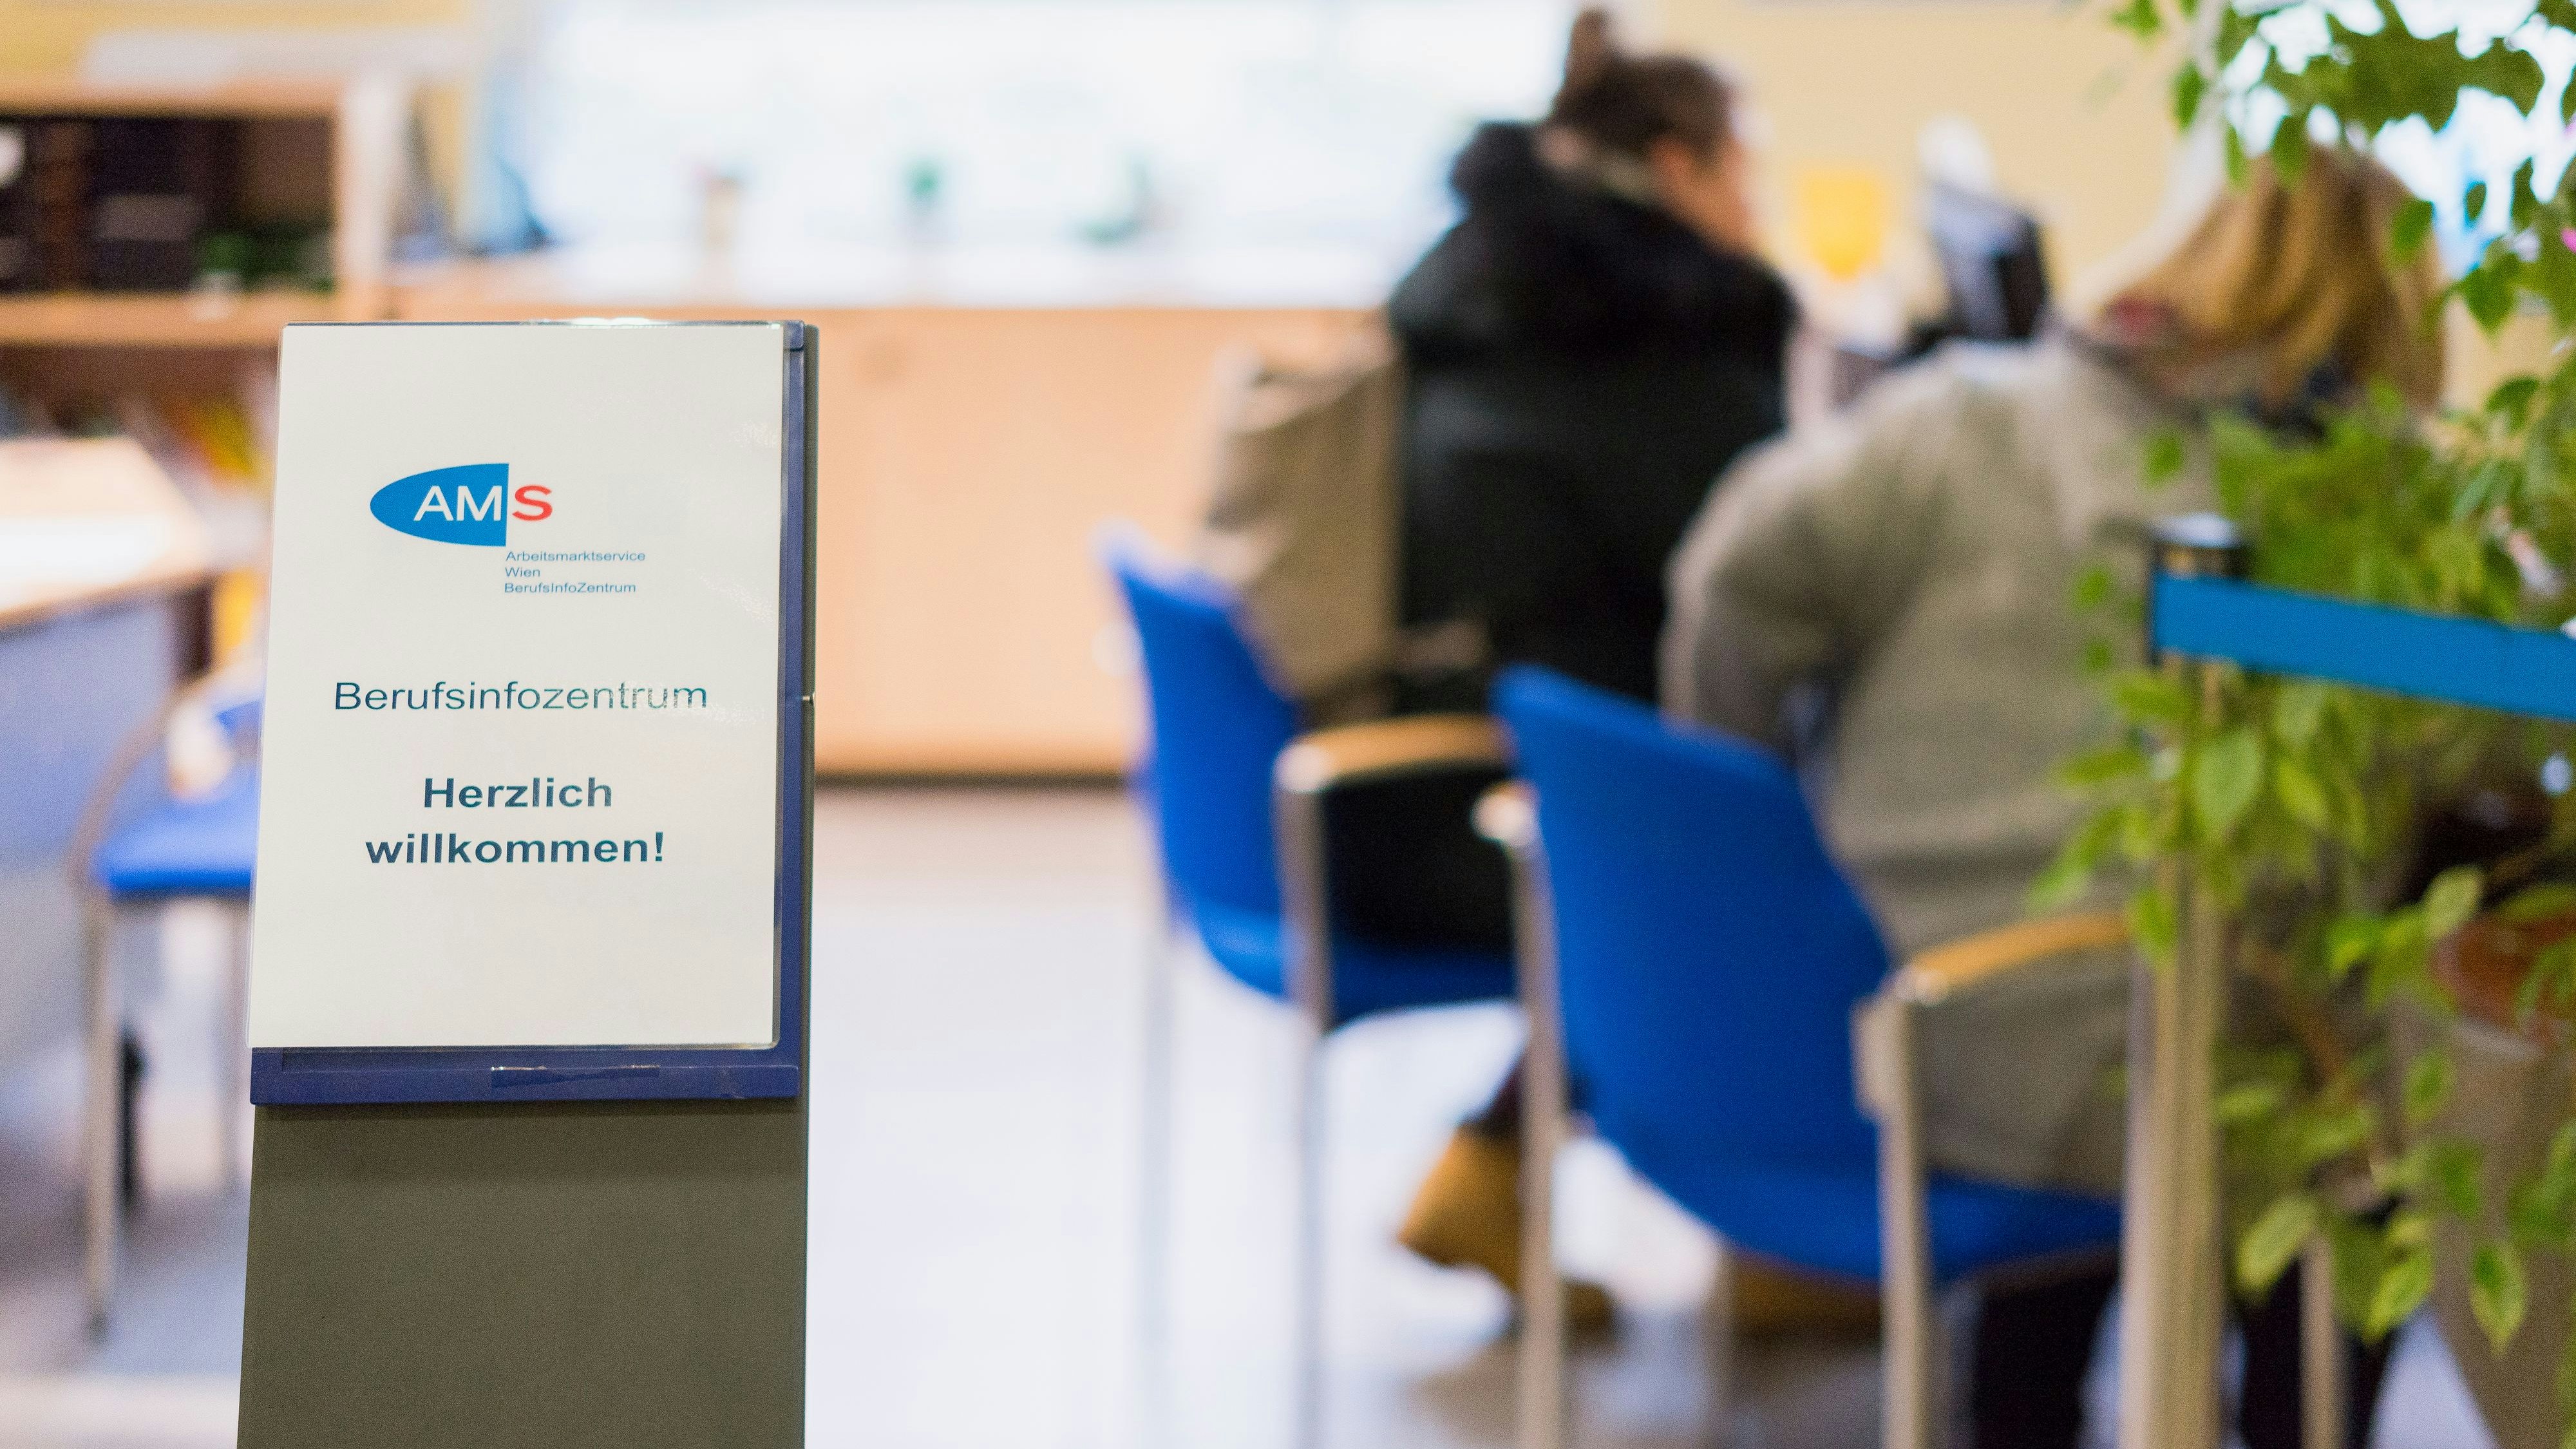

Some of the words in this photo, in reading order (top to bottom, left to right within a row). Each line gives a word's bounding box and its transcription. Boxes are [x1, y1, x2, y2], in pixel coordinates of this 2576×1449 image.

[413, 484, 554, 522] AMS
[505, 551, 646, 562] Arbeitsmarktservice
[505, 567, 541, 578] Wien
[504, 582, 637, 594] BerufsInfoZentrum
[334, 681, 708, 711] Berufsinfozentrum
[424, 777, 613, 809] Herzlich
[365, 832, 665, 865] willkommen!
